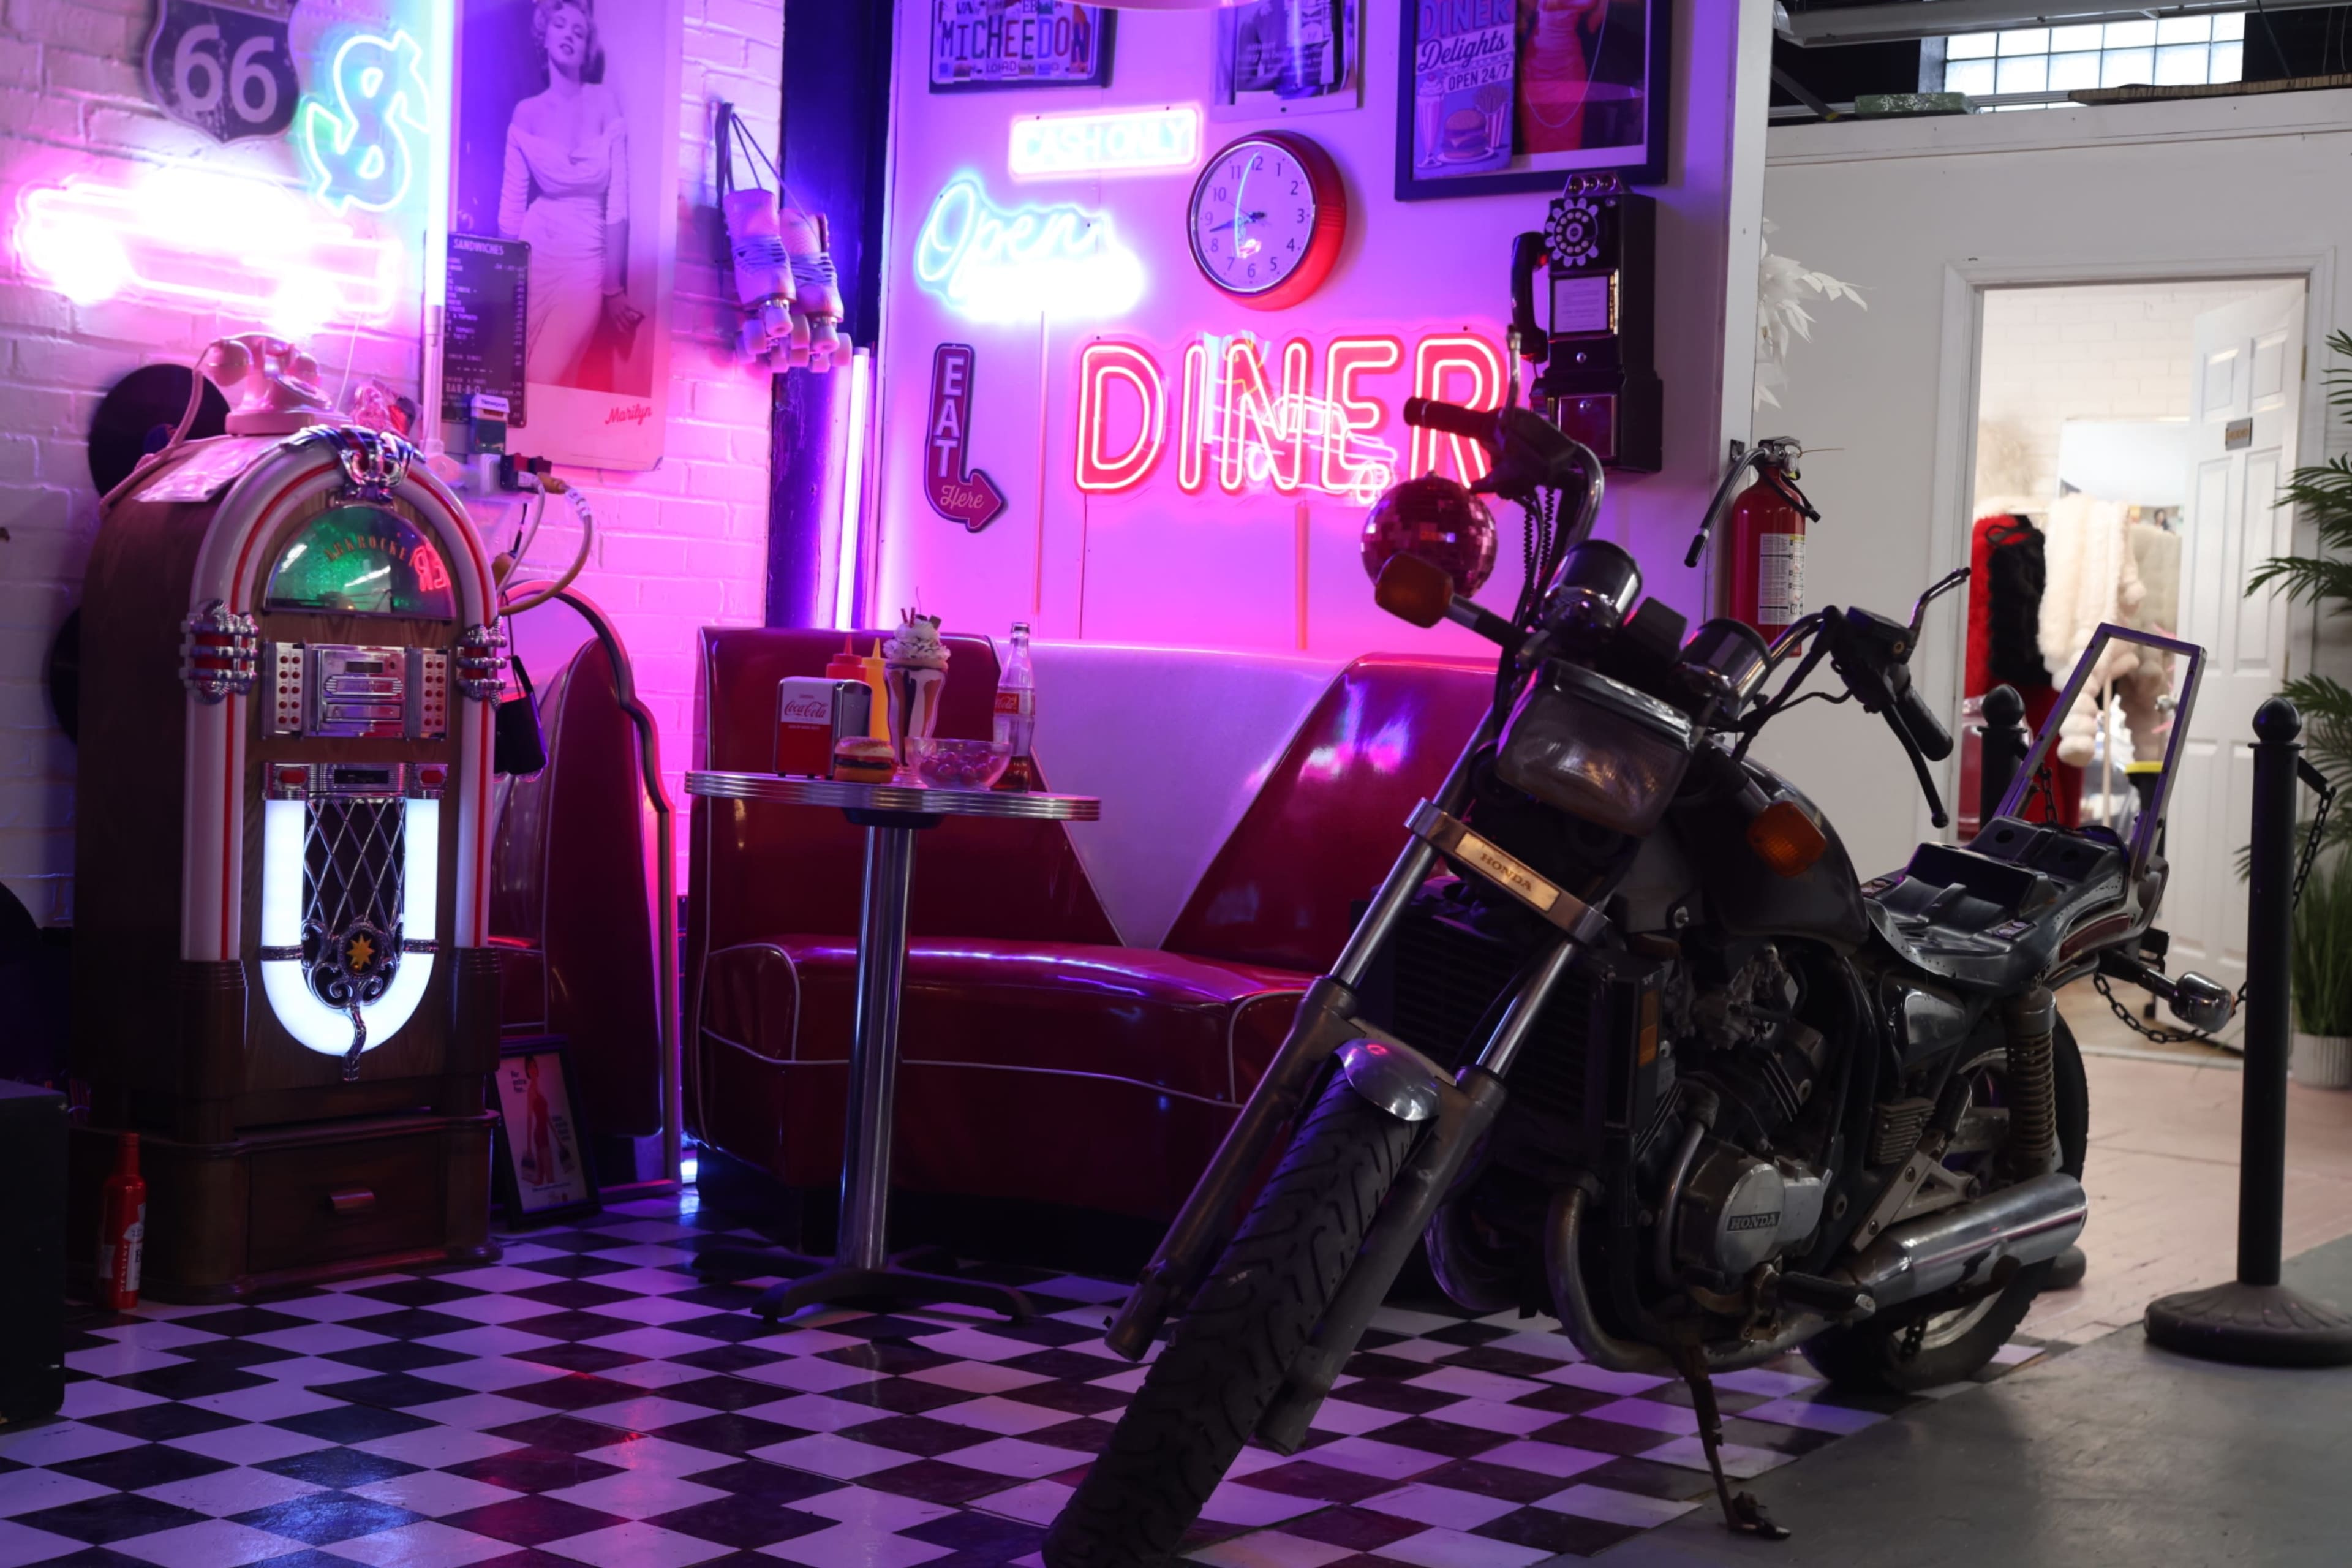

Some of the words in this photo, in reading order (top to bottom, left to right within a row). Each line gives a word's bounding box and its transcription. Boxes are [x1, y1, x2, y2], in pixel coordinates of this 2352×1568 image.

[1419, 0, 1510, 42] DINER
[940, 15, 1090, 62] MICHEEDON
[1417, 29, 1509, 72] Delights
[174, 23, 277, 123] 66
[1449, 69, 1479, 91] OPEN
[1481, 63, 1509, 83] 24/7
[1022, 124, 1100, 160] CASH
[1105, 118, 1189, 157] ONLY
[1231, 165, 1241, 179] 11
[1276, 162, 1281, 176] 1
[1213, 187, 1227, 201] 10
[1290, 181, 1299, 195] 2
[1205, 212, 1213, 225] 9
[1297, 208, 1305, 224] 3
[453, 238, 505, 255] SANDWICHES
[918, 182, 1101, 298] Open
[1210, 238, 1219, 252] 8
[1286, 238, 1295, 252] 4
[1227, 257, 1235, 271] 7
[1247, 263, 1256, 277] 6
[1270, 257, 1278, 271] 5
[605, 403, 652, 426] Marilyn
[933, 356, 965, 478] EAT
[1074, 333, 1508, 495] DINER
[940, 484, 984, 510] Here
[1479, 852, 1532, 892] HONDA
[1730, 1213, 1777, 1229] HONDA
